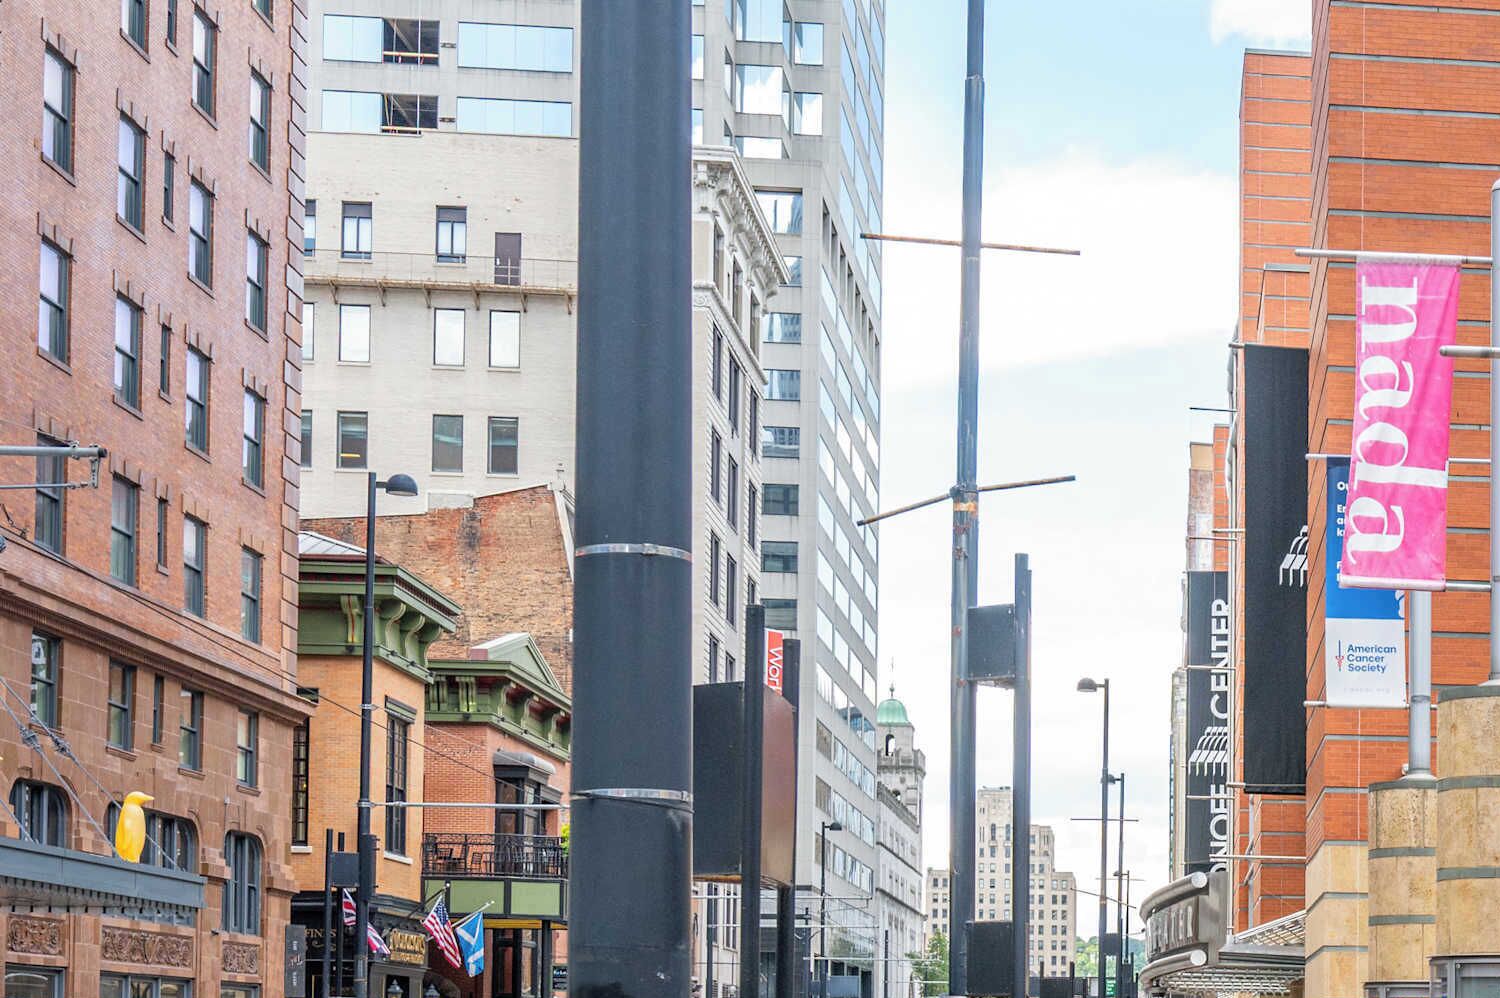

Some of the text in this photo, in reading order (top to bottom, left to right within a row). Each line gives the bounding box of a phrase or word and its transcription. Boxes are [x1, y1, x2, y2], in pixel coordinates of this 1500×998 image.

[1346, 276, 1449, 565] nada
[1347, 644, 1397, 653] American
[1347, 654, 1385, 663] Cancer
[1347, 663, 1386, 674] Society
